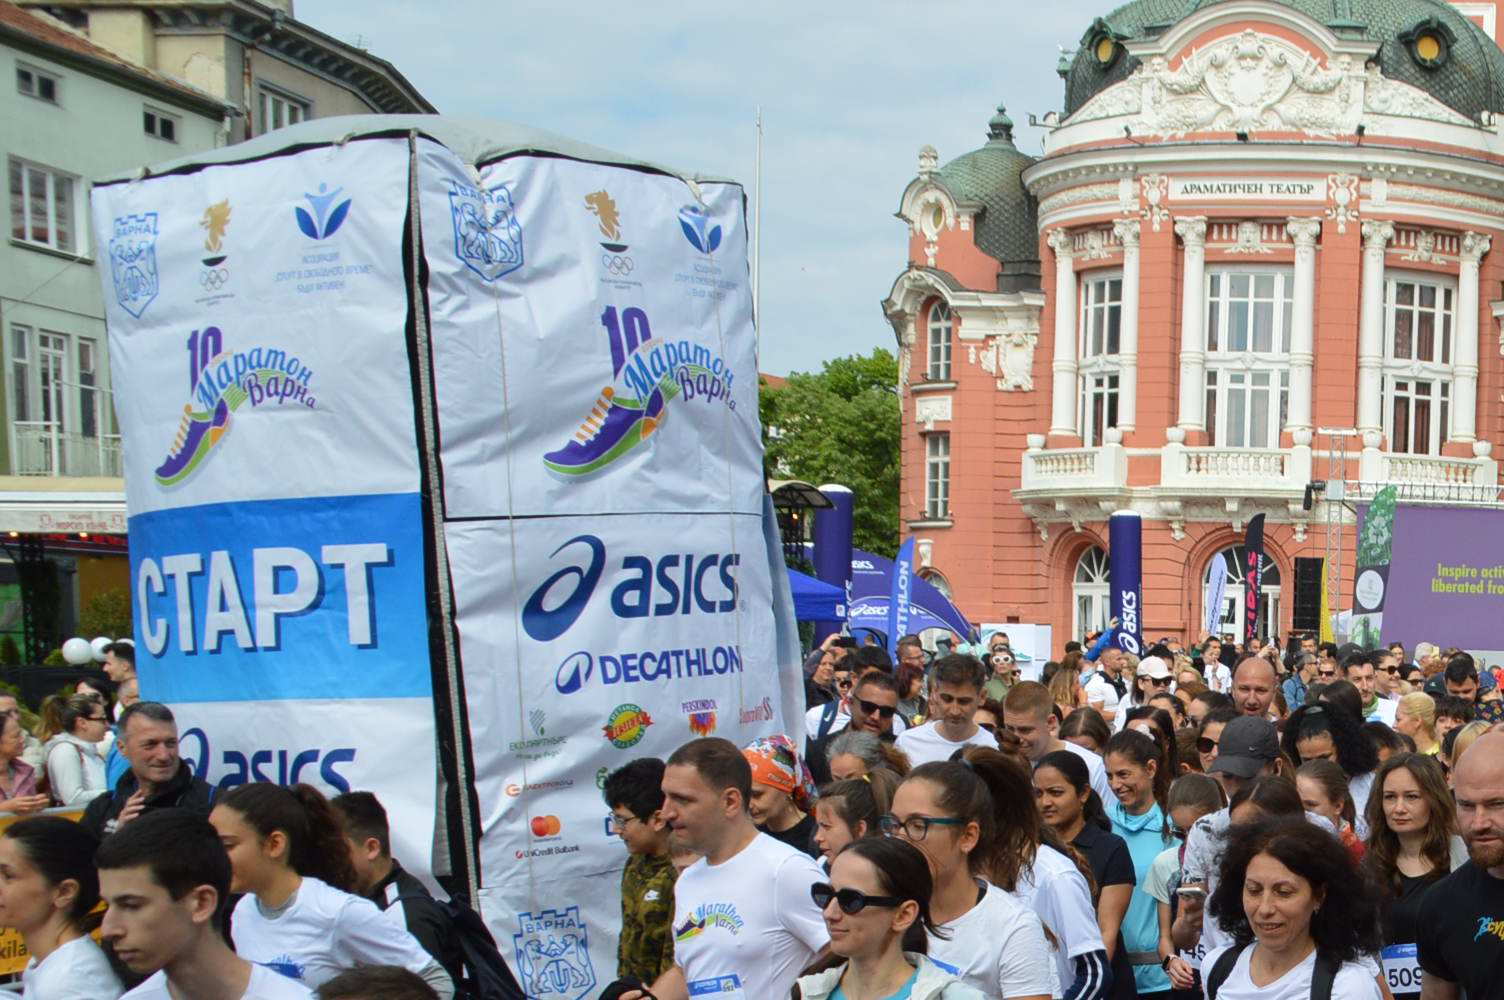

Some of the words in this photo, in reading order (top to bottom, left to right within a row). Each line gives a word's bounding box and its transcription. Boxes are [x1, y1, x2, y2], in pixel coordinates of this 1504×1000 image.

[1181, 183, 1264, 195] ДРАМАТИЧЕН
[1268, 183, 1315, 195] ТЕАТЪР
[187, 327, 222, 398] 10
[601, 305, 652, 381] 10
[197, 347, 313, 408] Маратон
[243, 372, 317, 409] Варна
[624, 340, 734, 403] Маратон
[676, 365, 736, 411] Варна
[1431, 578, 1484, 594] liberated
[1438, 563, 1478, 580] Inspire
[138, 543, 394, 657] СТАРТ
[896, 560, 910, 641] ATHLON
[600, 644, 743, 686] DECATHLON
[525, 918, 577, 934] ВАРНА
